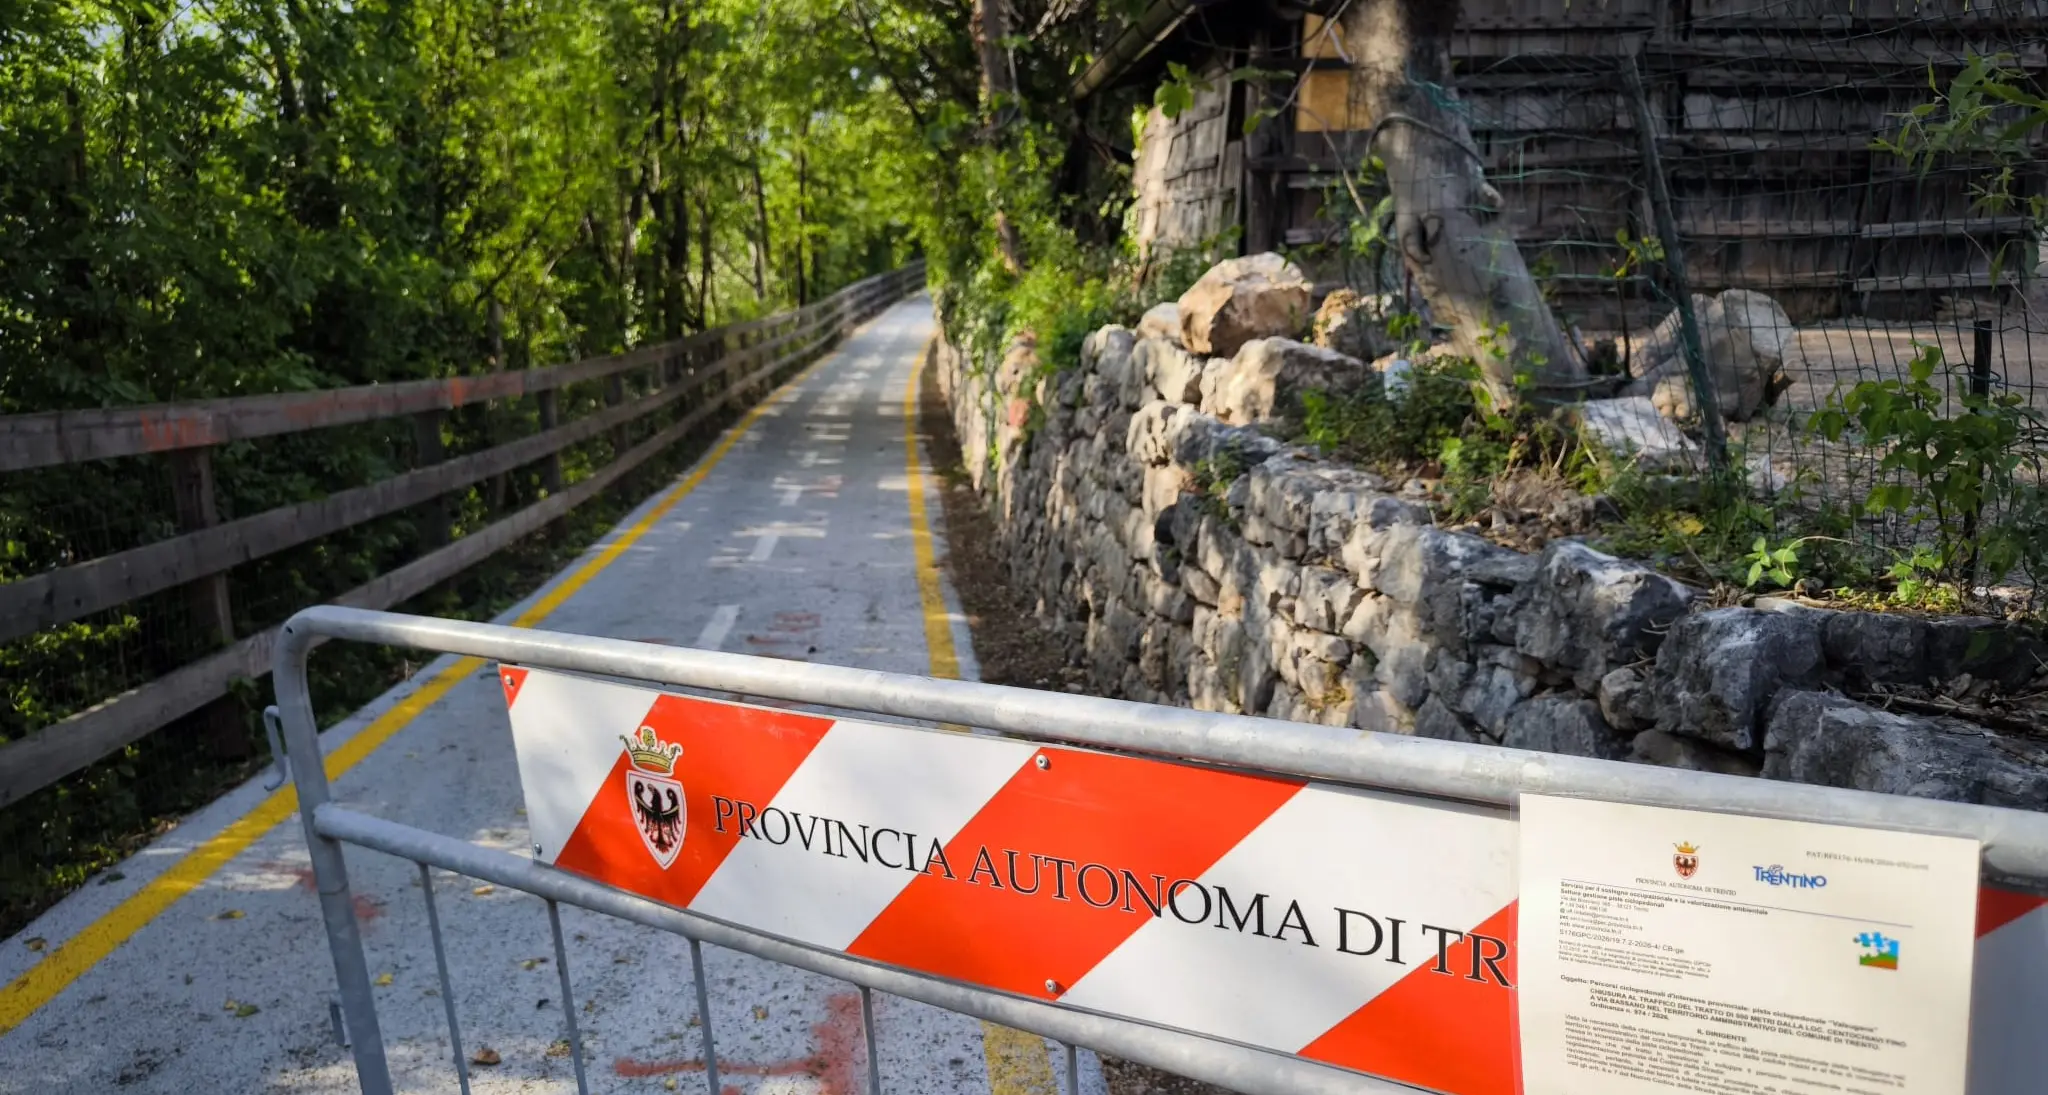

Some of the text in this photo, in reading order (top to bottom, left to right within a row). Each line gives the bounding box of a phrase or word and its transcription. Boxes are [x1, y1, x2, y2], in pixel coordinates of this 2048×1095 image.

[1635, 878, 1667, 886] PROVINCIA
[1669, 883, 1703, 891] AUTONOMA
[1712, 888, 1736, 896] TRENTO
[1752, 865, 1827, 890] TRENTINO
[711, 795, 956, 880] PROVINCIA
[967, 844, 1318, 948] AUTONOMA
[1334, 907, 1406, 965] DI
[1422, 923, 1516, 989] TR
[1601, 888, 1629, 896] sostegno
[1629, 893, 1673, 902] occupazionale
[1687, 901, 1731, 910] valorizzazione
[1732, 907, 1768, 915] ambientale
[1624, 899, 1665, 907] ciclopedonali
[1560, 975, 1588, 983] Oggetto:
[1590, 980, 1618, 989] Percorsi
[1619, 986, 1666, 997] ciclopedonali
[1667, 994, 1706, 1004] d'interesse
[1772, 1012, 1827, 1024] ciclopedonale
[1590, 1002, 1624, 1012] Ordinanza
[1590, 989, 1626, 999] CHIUSURA
[1640, 997, 1676, 1007] TRAFFICO
[1694, 1006, 1724, 1016] TRATTO
[1750, 1016, 1775, 1025] METRI
[1776, 1020, 1804, 1030] DALLA
[1609, 999, 1645, 1009] BASSANO
[1663, 1008, 1709, 1020] TERRITORIO
[1710, 1017, 1777, 1031] AMMINISTRATIVO
[1795, 1031, 1832, 1041] COMUNE
[1705, 1031, 1747, 1042] DIRIGENTE
